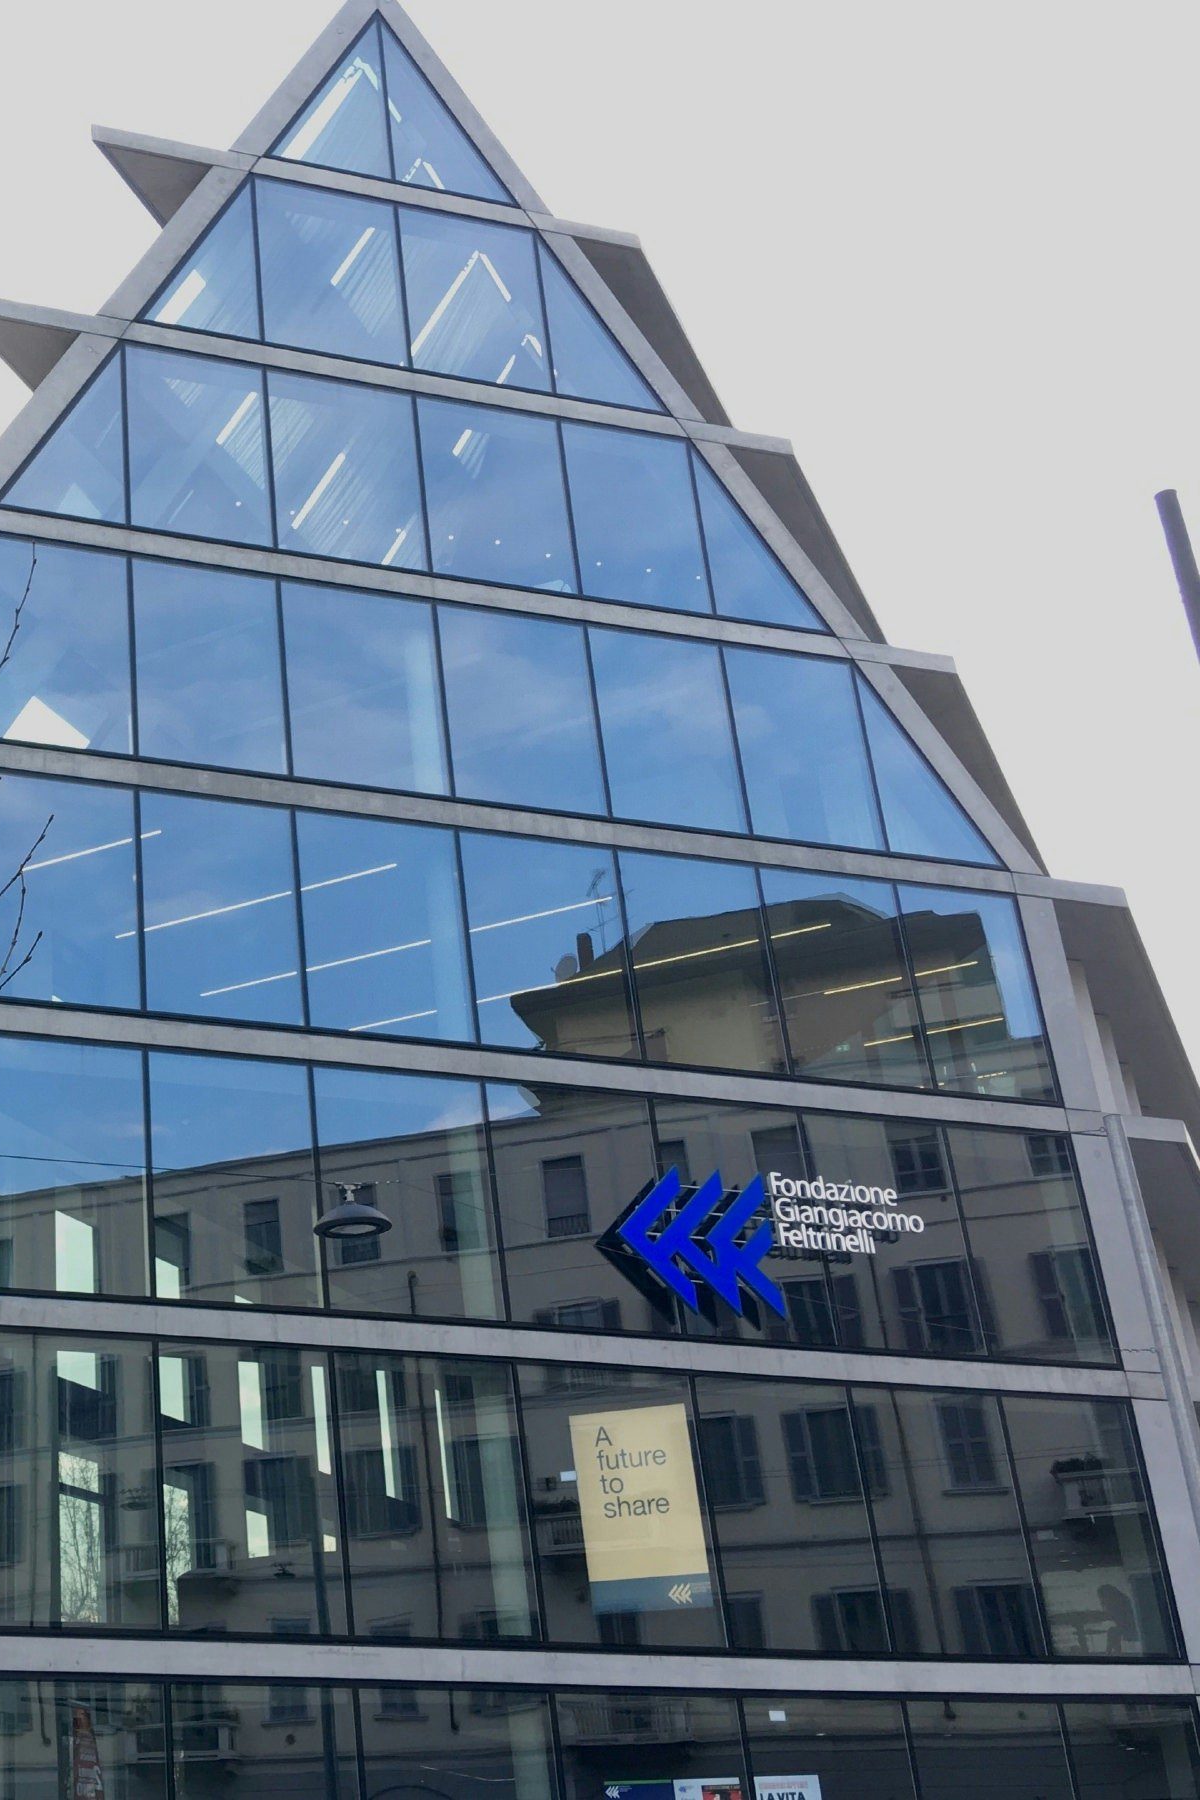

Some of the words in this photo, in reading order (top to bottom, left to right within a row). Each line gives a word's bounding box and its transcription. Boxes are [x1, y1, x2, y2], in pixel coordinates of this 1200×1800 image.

[769, 1171, 898, 1206] Fondazione
[774, 1199, 925, 1233] Giangiacomo
[778, 1222, 876, 1254] Feltrinelli
[595, 1426, 612, 1447] A
[596, 1449, 667, 1471] future
[599, 1475, 624, 1494] to
[604, 1496, 670, 1518] share
[776, 1791, 806, 1800] VITA
